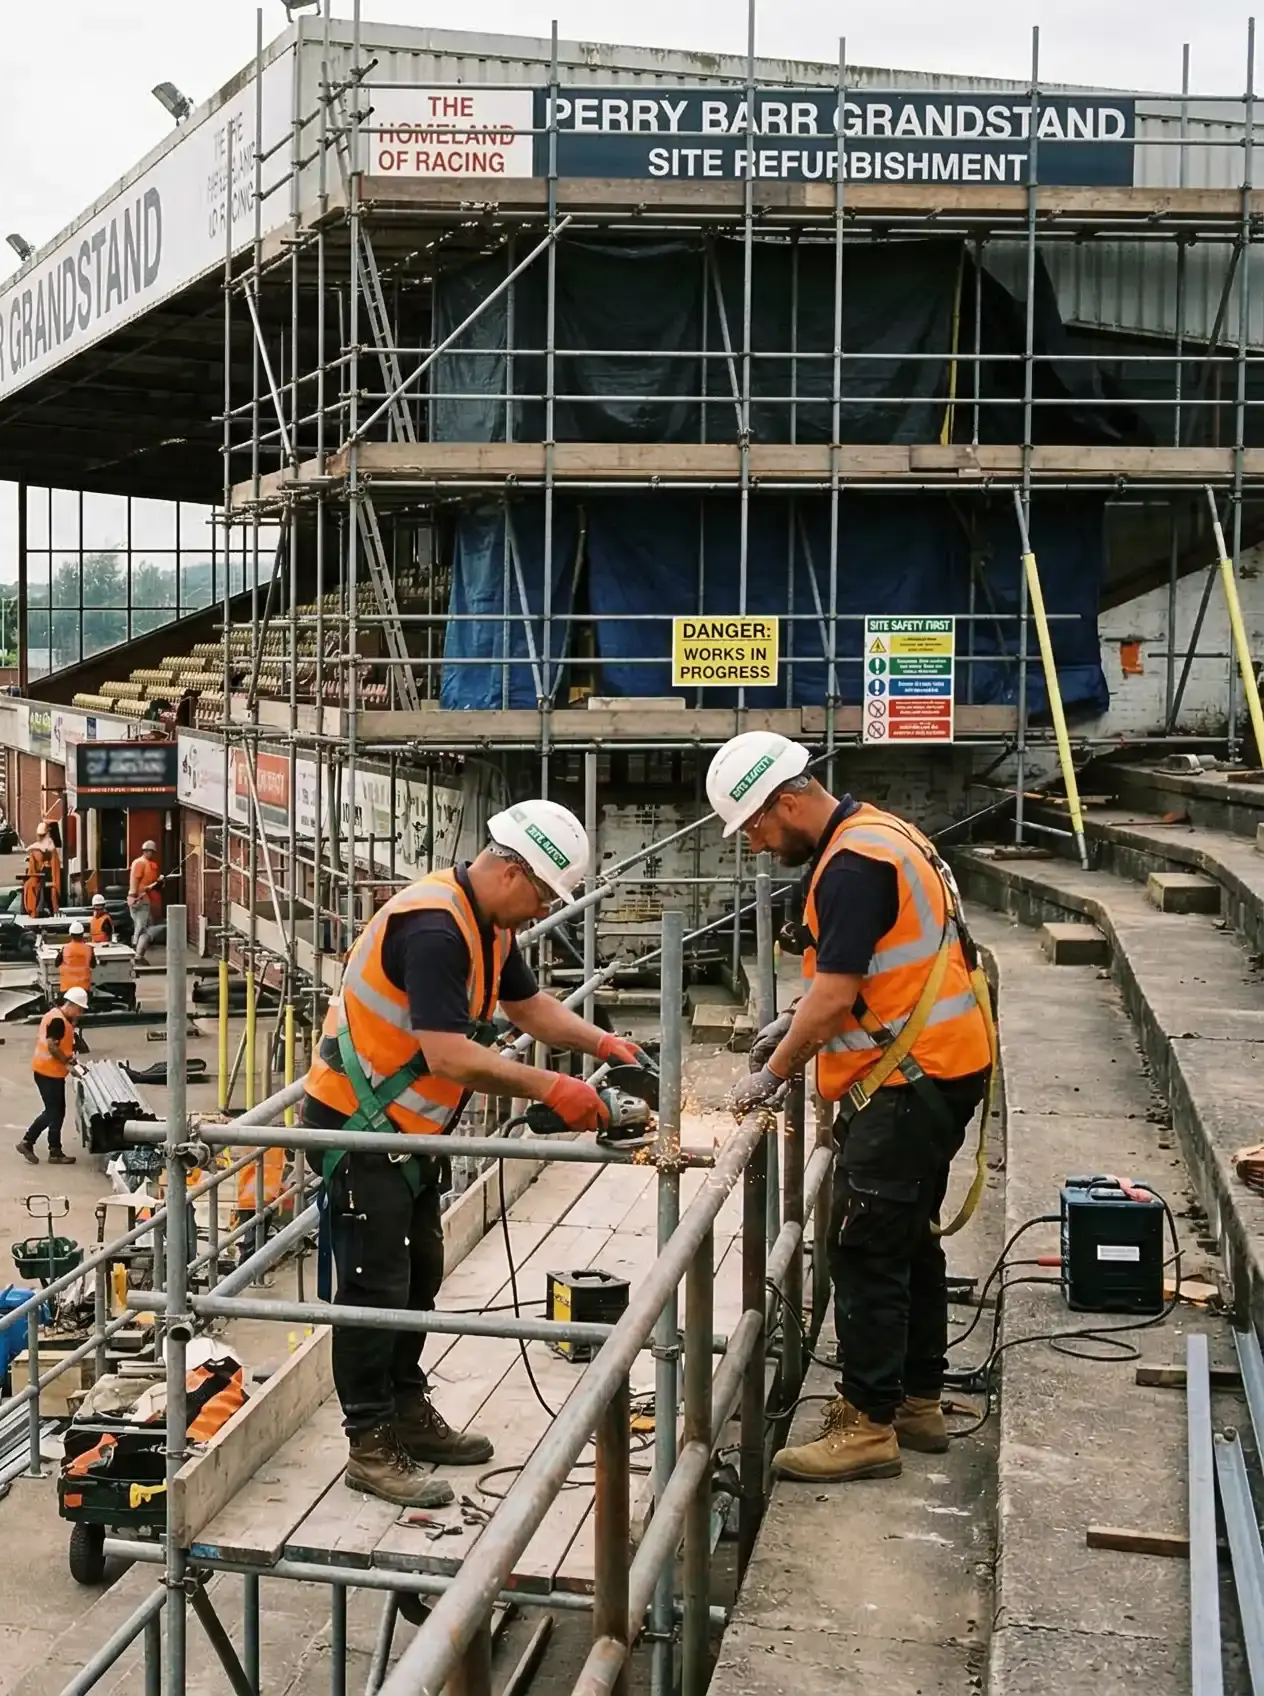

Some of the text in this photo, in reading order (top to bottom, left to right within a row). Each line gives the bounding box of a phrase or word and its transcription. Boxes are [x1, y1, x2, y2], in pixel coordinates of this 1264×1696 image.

[428, 96, 474, 117] THE
[545, 98, 1126, 138] PERRY BARR GRANDSTAND
[378, 122, 516, 146] HOMELAND
[378, 150, 505, 173] OF RACING
[648, 147, 1028, 182] SITE REFURBISHMENT
[10, 187, 162, 375] GRANDSTAND
[683, 623, 771, 639] DANGER:
[870, 620, 889, 630] SITE
[891, 620, 923, 631] SAFETY
[684, 647, 766, 661] WORKS IN
[680, 665, 770, 679] PROGRESS
